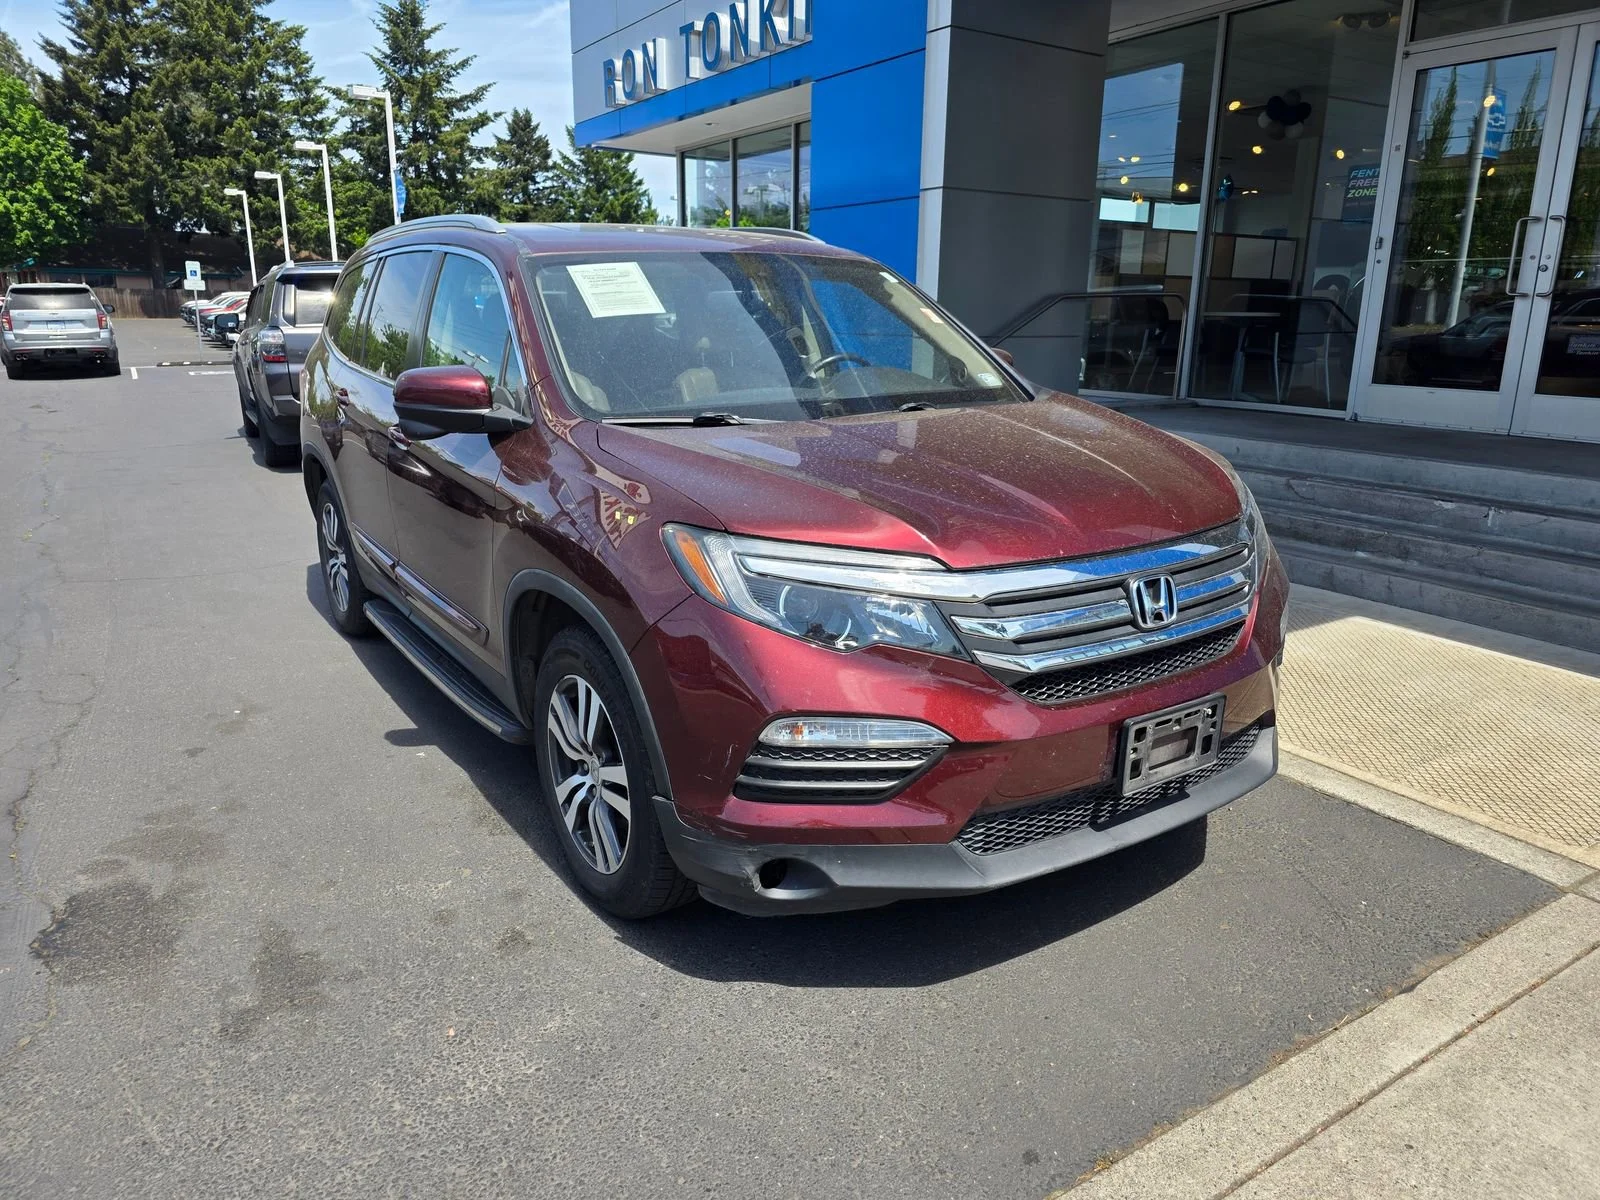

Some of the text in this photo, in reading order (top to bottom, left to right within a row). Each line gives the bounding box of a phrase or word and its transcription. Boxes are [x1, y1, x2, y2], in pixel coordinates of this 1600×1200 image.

[603, 38, 664, 108] RON
[1348, 178, 1379, 188] FREE
[1347, 188, 1377, 198] ZONE
